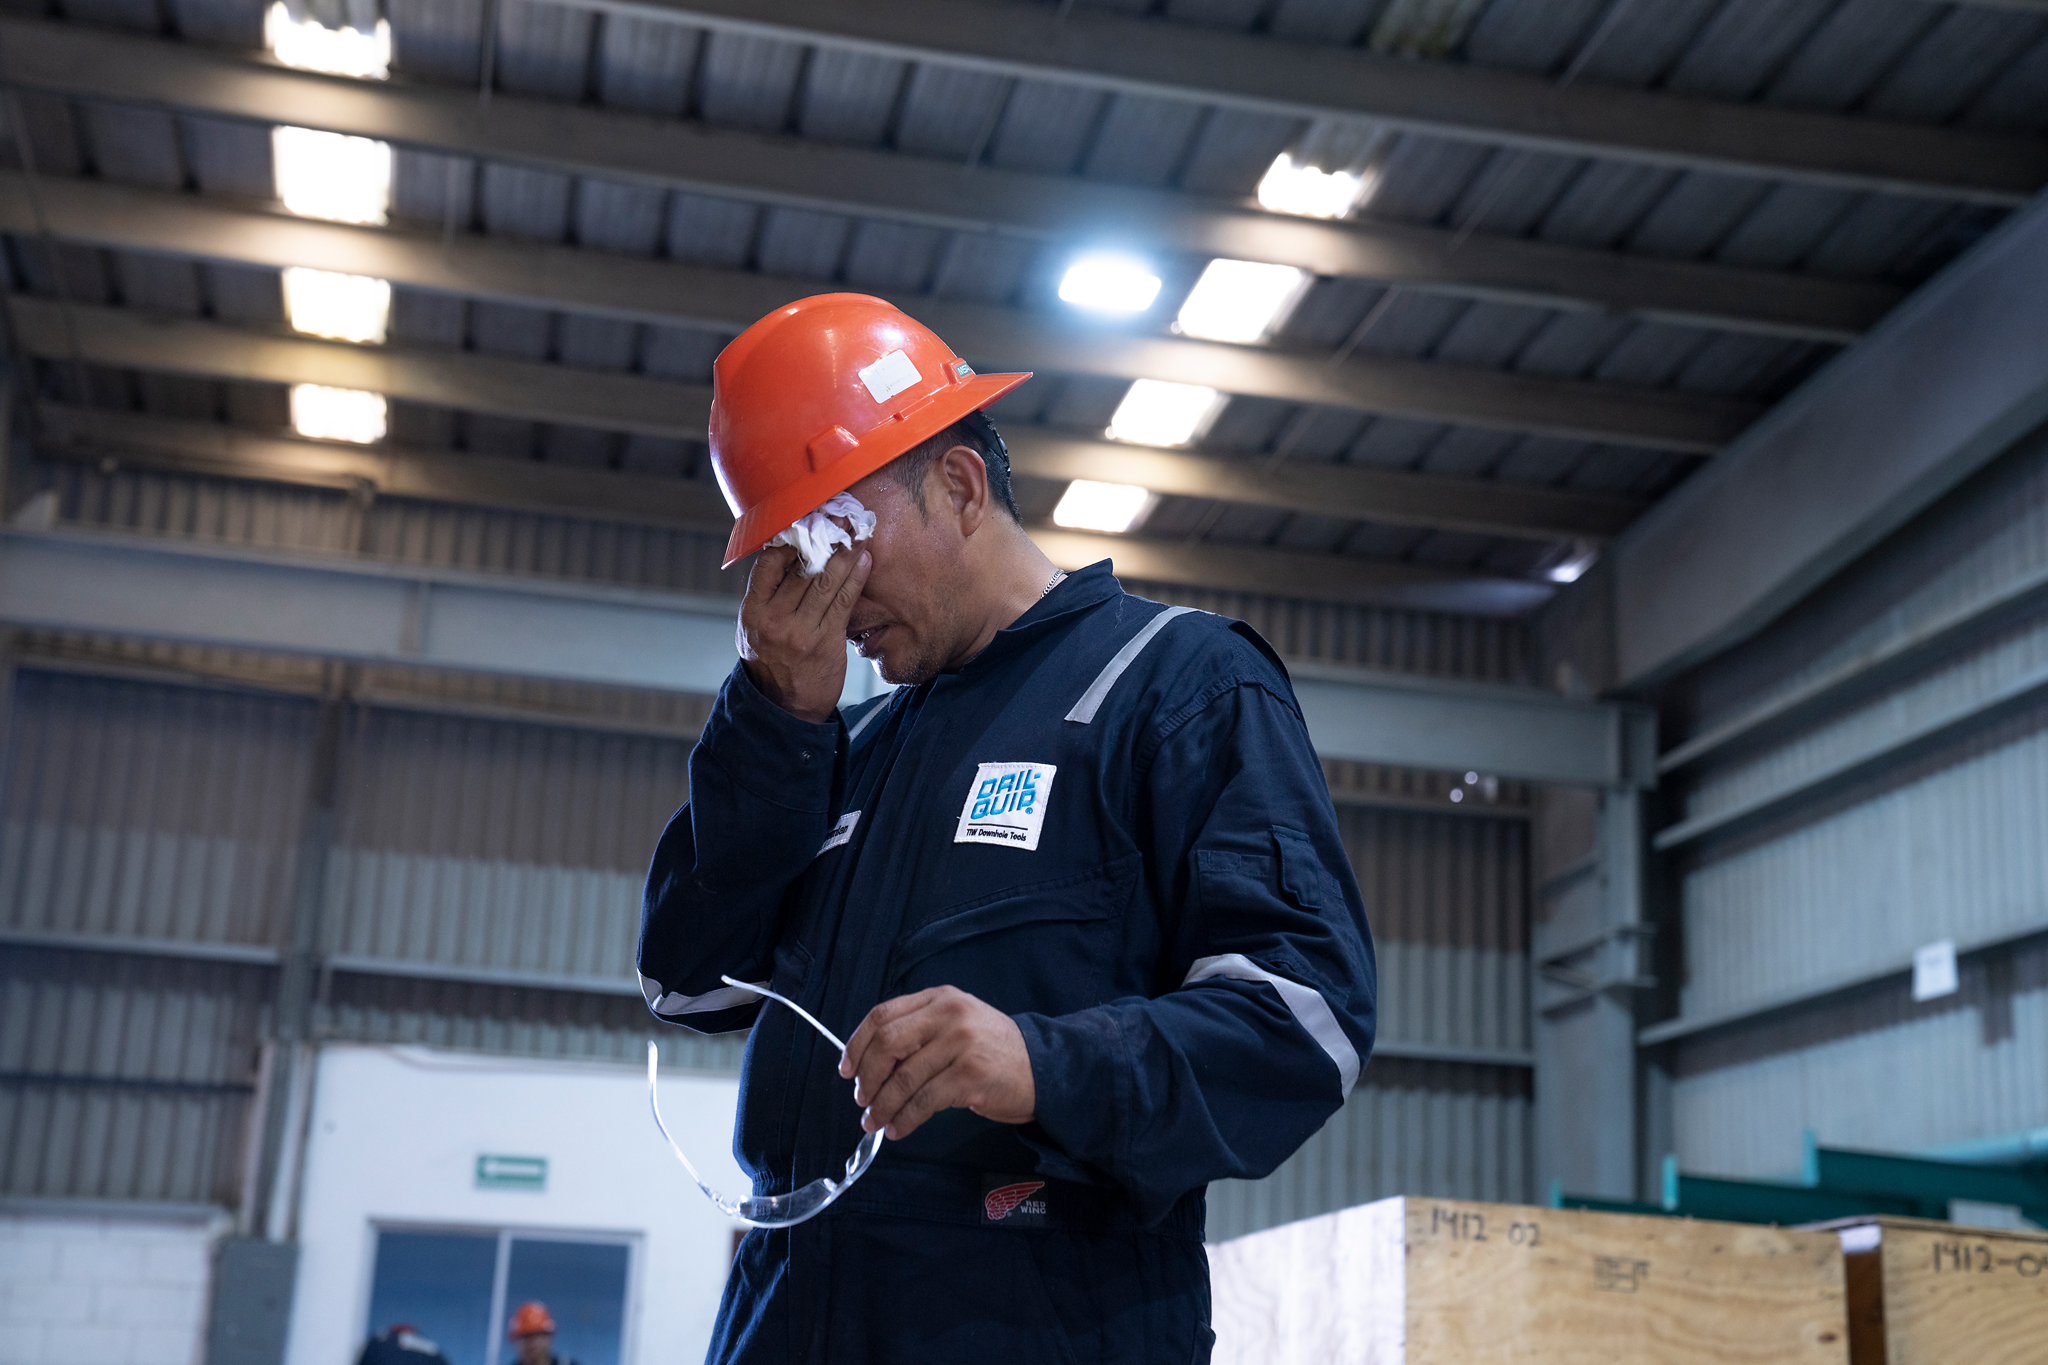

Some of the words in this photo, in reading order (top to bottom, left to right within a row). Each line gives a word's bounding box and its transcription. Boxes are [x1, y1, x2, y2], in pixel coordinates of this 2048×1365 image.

[978, 829, 1008, 839] Downhole
[1010, 831, 1026, 841] Tools
[1026, 1200, 1046, 1208] RED
[1020, 1206, 1046, 1214] WING
